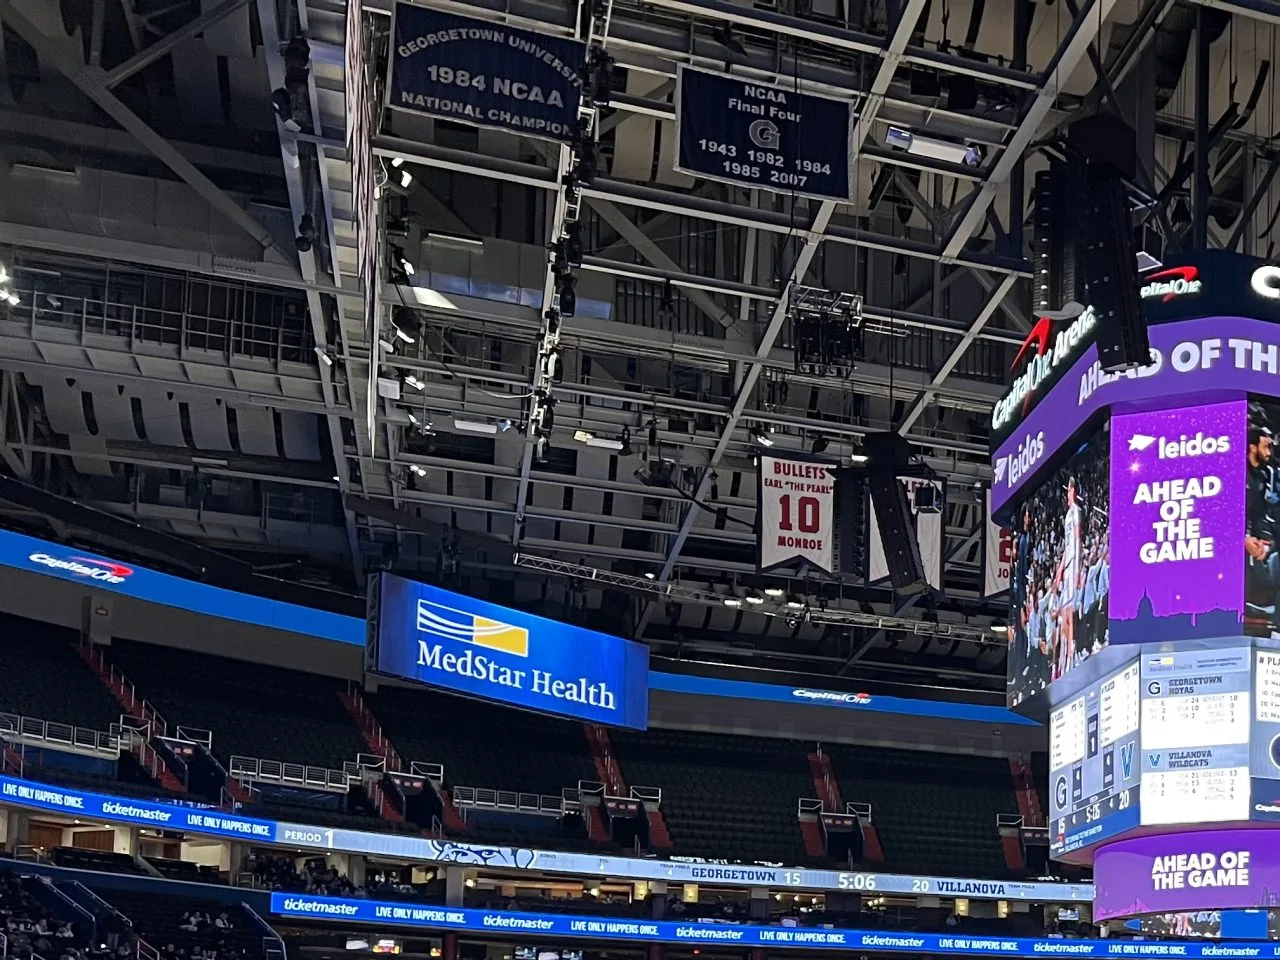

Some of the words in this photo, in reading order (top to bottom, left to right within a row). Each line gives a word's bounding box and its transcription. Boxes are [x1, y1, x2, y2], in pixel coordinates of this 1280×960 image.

[398, 28, 504, 58] GEORGETOWN
[508, 35, 583, 87] UNIVERSIT
[427, 65, 486, 92] 1984
[493, 77, 564, 108] NCAA
[744, 85, 787, 104] NCAA
[402, 91, 484, 119] NATIONAL
[728, 98, 765, 116] Final
[770, 107, 802, 123] Four
[749, 119, 781, 150] G
[699, 138, 737, 157] 1943
[748, 150, 784, 168] 1982
[795, 159, 831, 175] 1984
[723, 161, 761, 178] 1985
[770, 170, 808, 187] 2007
[1052, 304, 1097, 367] Arena
[1171, 339, 1221, 373] OF
[1158, 432, 1230, 459] leidos
[1008, 430, 1044, 488] leidos
[774, 462, 826, 480] BULLETS
[764, 478, 783, 490] EARL
[1133, 476, 1222, 505] AHEAD
[778, 494, 820, 534] 10
[1160, 499, 1194, 521] OF
[1153, 519, 1201, 543] THE
[777, 535, 822, 550] MONROE
[1139, 537, 1214, 564] GAME
[418, 640, 525, 690] MedStar
[531, 669, 617, 711] Health
[1169, 676, 1222, 687] GEORGETOWN
[1148, 681, 1161, 695] G
[1169, 687, 1194, 695] HOYAS
[1169, 750, 1212, 760] VILLANOVA
[1169, 759, 1209, 768] WILDCATS
[1119, 789, 1130, 810] 20
[103, 802, 171, 820] ticketmaster
[284, 830, 322, 843] PERIOD
[324, 831, 334, 849] 1
[1152, 853, 1216, 875] AHEAD
[1220, 851, 1250, 871] OF
[691, 867, 776, 882] GEORGETOWN
[784, 871, 801, 884] 15
[838, 873, 876, 890] 5:06
[1152, 871, 1185, 890] THE
[1188, 867, 1249, 888] GAME
[912, 879, 929, 893] 20
[936, 880, 1005, 895] VILLANOVA
